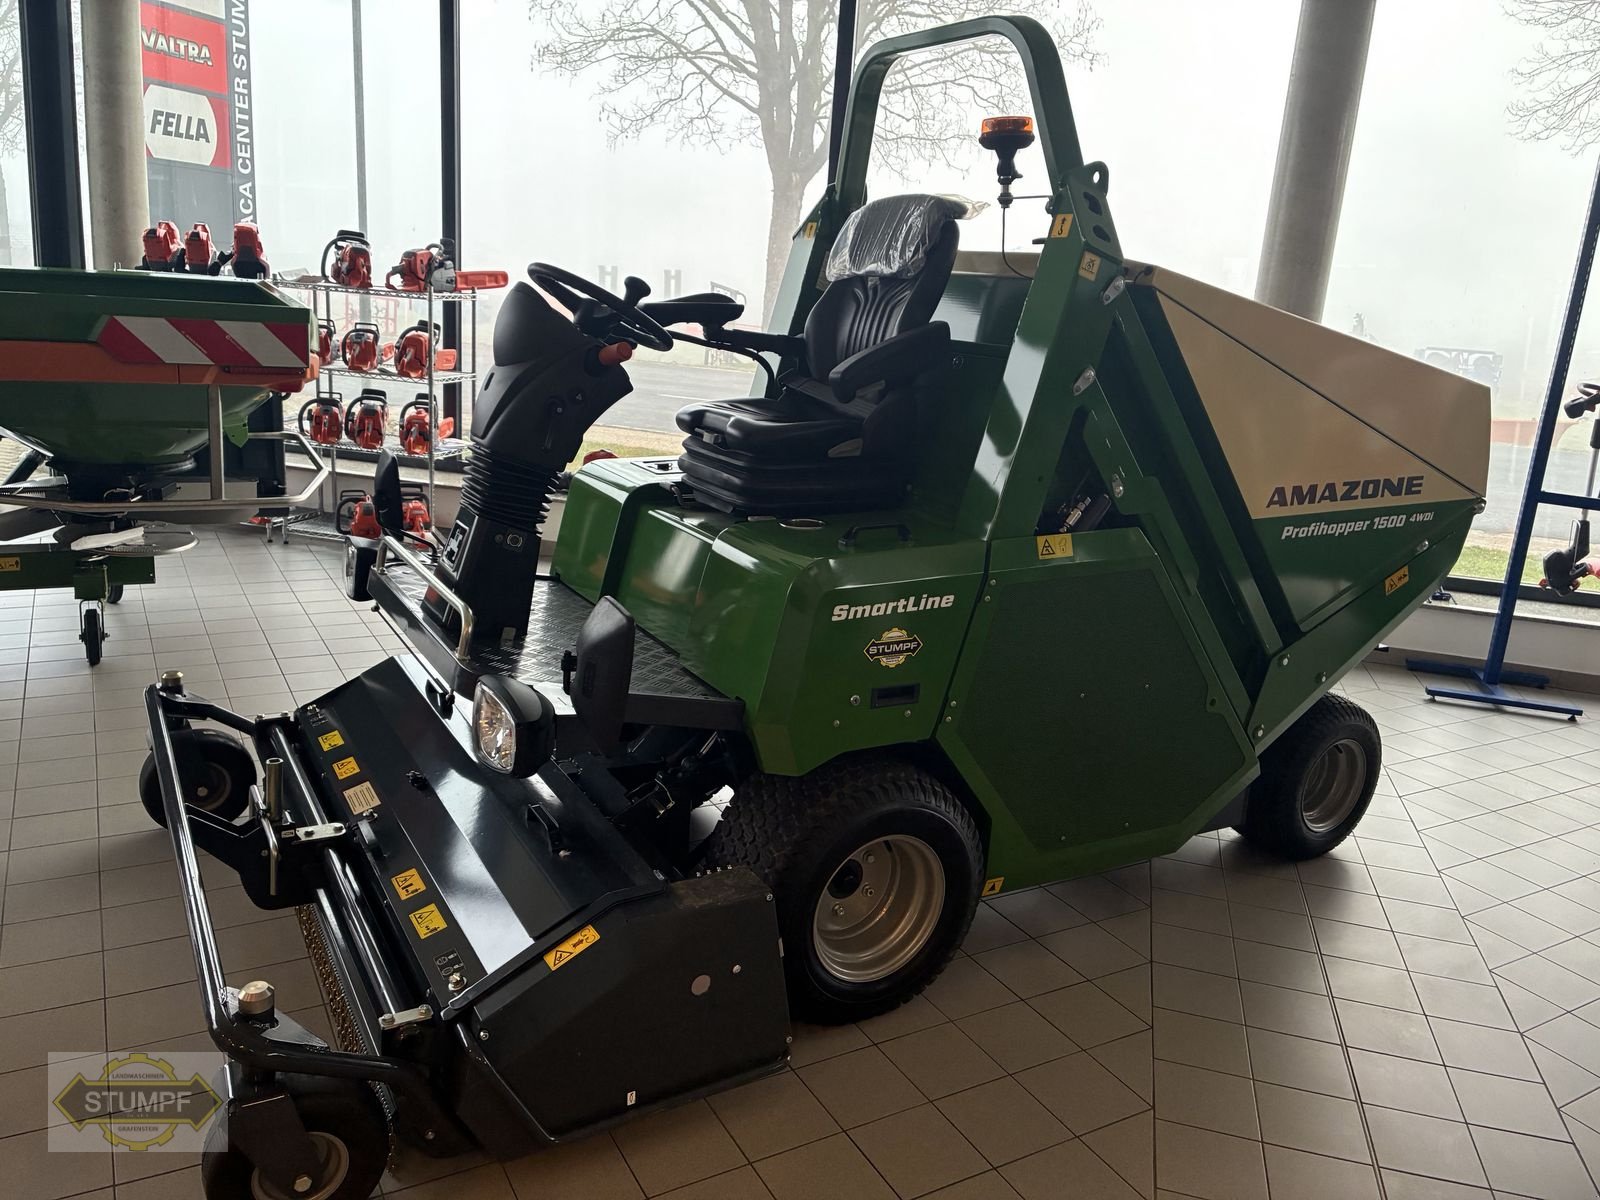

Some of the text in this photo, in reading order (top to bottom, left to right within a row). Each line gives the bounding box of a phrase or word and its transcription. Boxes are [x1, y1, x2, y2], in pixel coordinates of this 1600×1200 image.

[141, 28, 213, 66] VALTRA
[150, 109, 210, 144] FELLA
[234, 77, 251, 174] CENTER
[1265, 475, 1425, 509] AMAZONE
[1281, 519, 1371, 541] Profihopper
[1372, 513, 1407, 530] 1500
[831, 593, 955, 622] SmartLine
[868, 641, 919, 655] STUMPF
